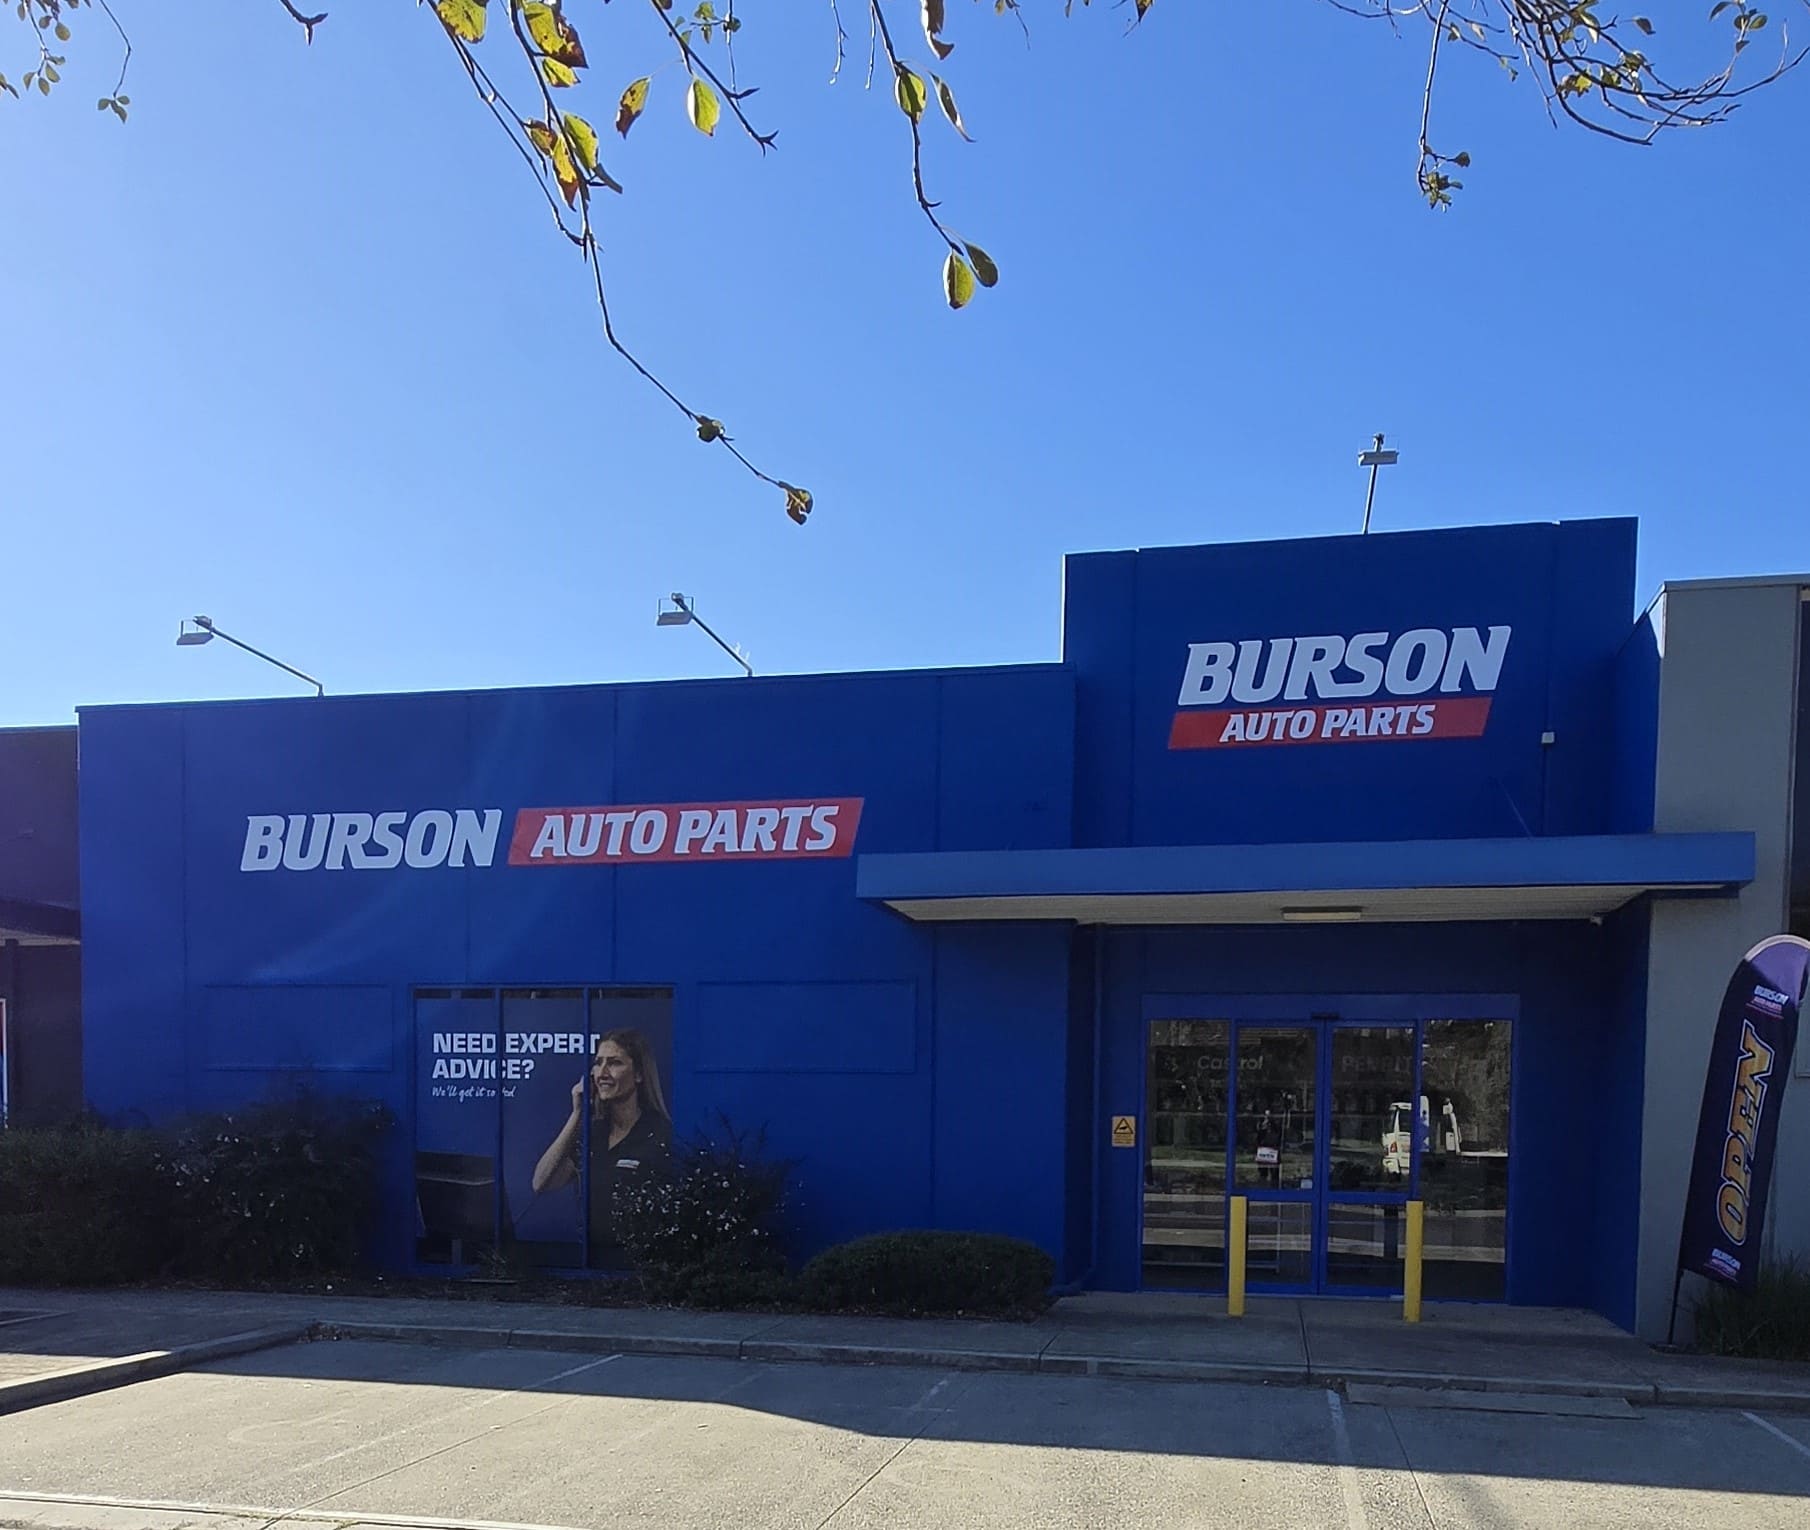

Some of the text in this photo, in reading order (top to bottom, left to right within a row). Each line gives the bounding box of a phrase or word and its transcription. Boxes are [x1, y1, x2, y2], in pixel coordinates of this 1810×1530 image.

[1177, 625, 1512, 706] BURSON
[1219, 704, 1436, 743] AUTO PARTS
[240, 805, 840, 871] BURSON AUTO PARTS
[433, 1033, 496, 1053] NEED
[432, 1059, 535, 1079] ADVICE?
[432, 1085, 457, 1097] We'll
[459, 1086, 475, 1103] get
[475, 1086, 486, 1097] it
[1716, 1019, 1776, 1247] OPEN
